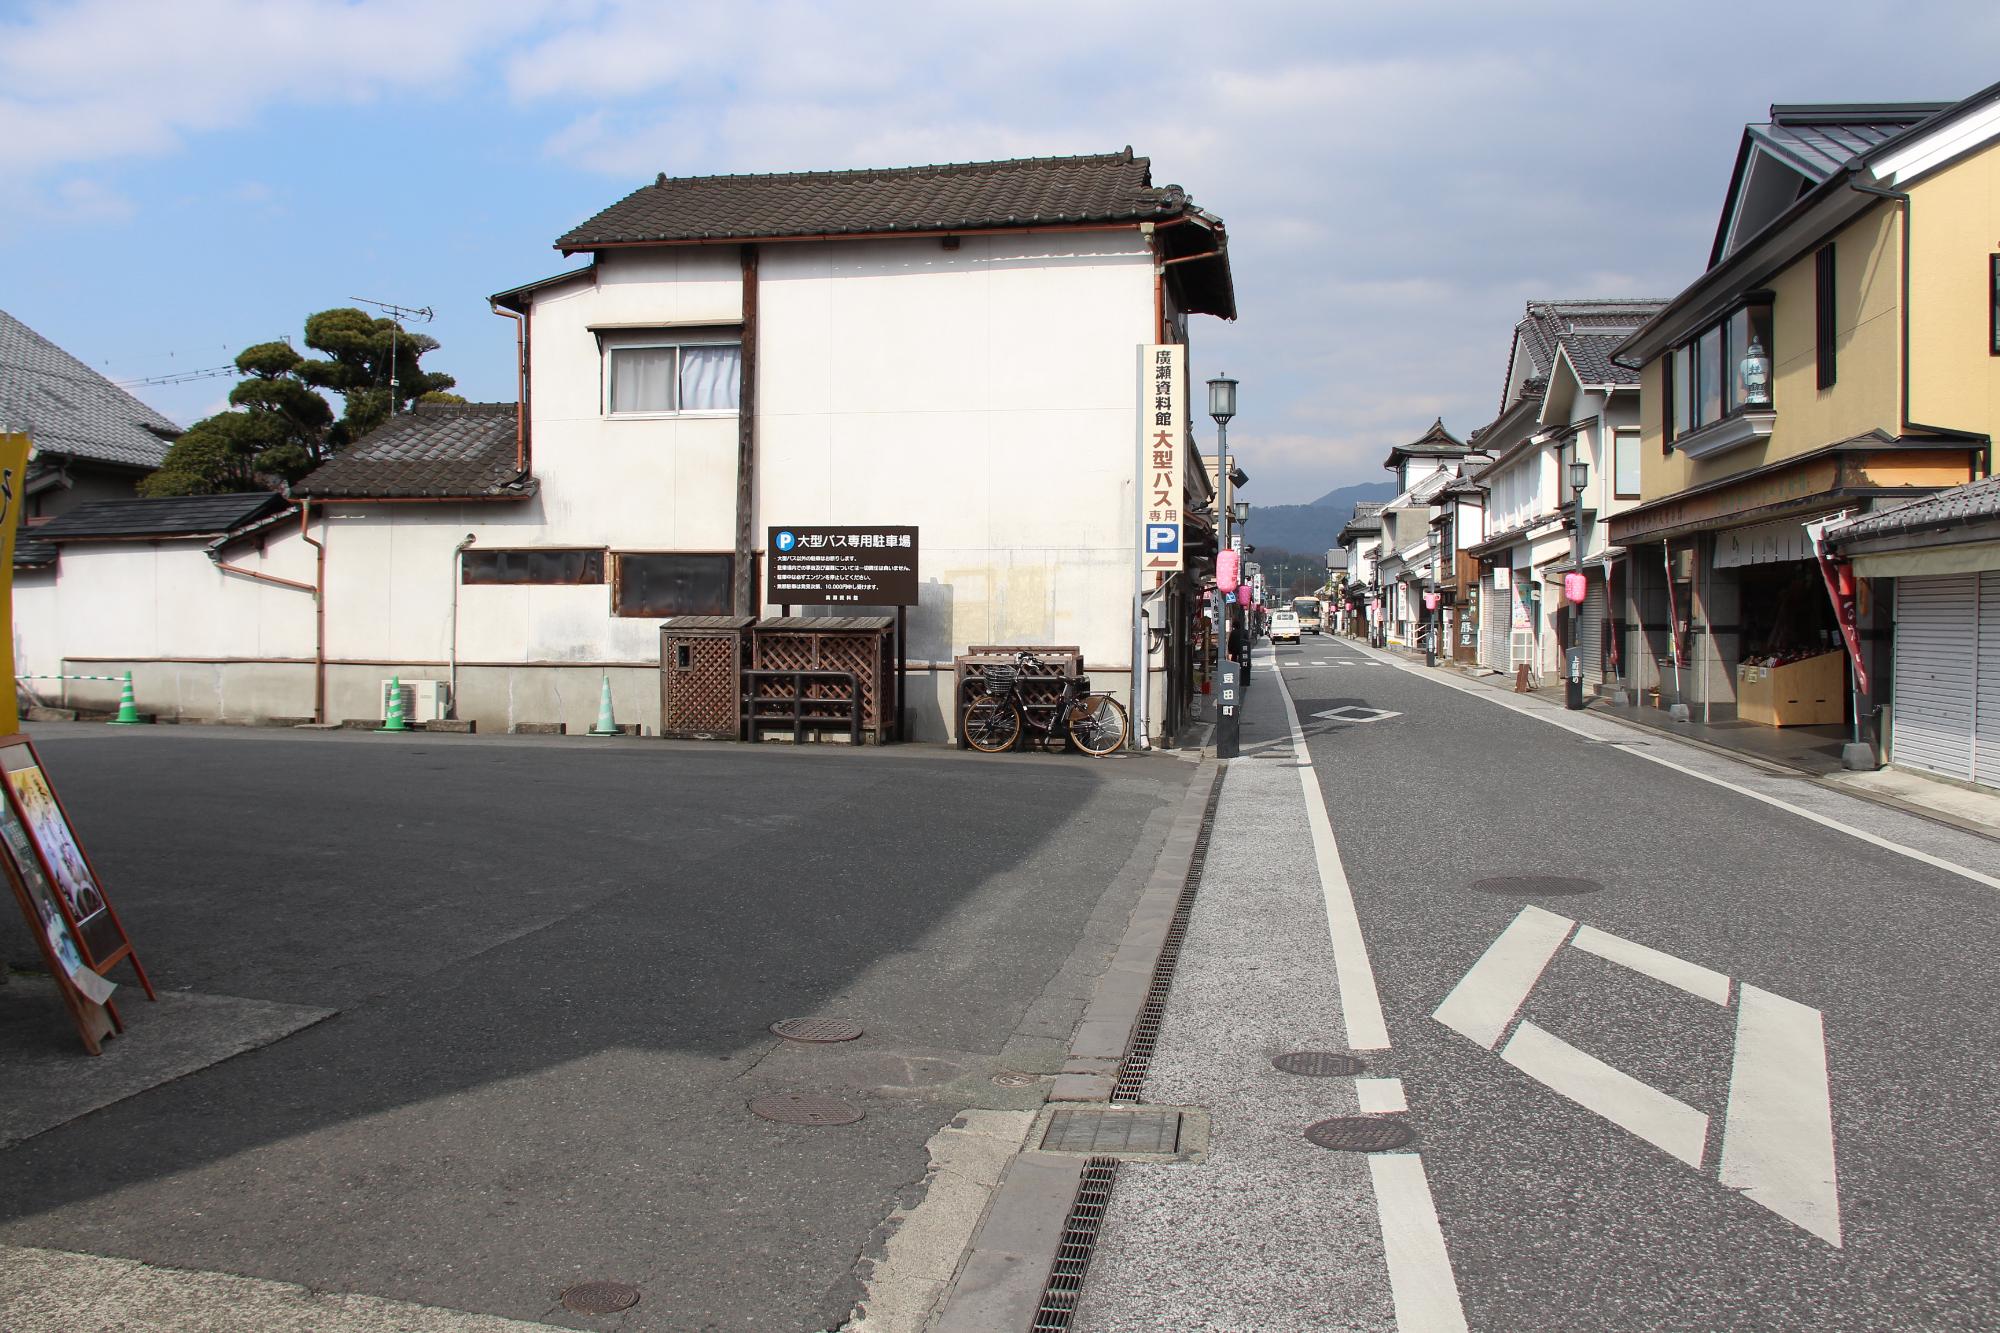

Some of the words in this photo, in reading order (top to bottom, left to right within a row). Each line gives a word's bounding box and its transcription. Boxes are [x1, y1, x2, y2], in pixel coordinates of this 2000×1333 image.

[1155, 350, 1172, 426] 廣瀬資料館
[1152, 430, 1174, 507] 大型バス
[1148, 509, 1177, 522] 専用
[797, 534, 911, 548] 大型バス専用駐車場
[1149, 528, 1176, 550] P
